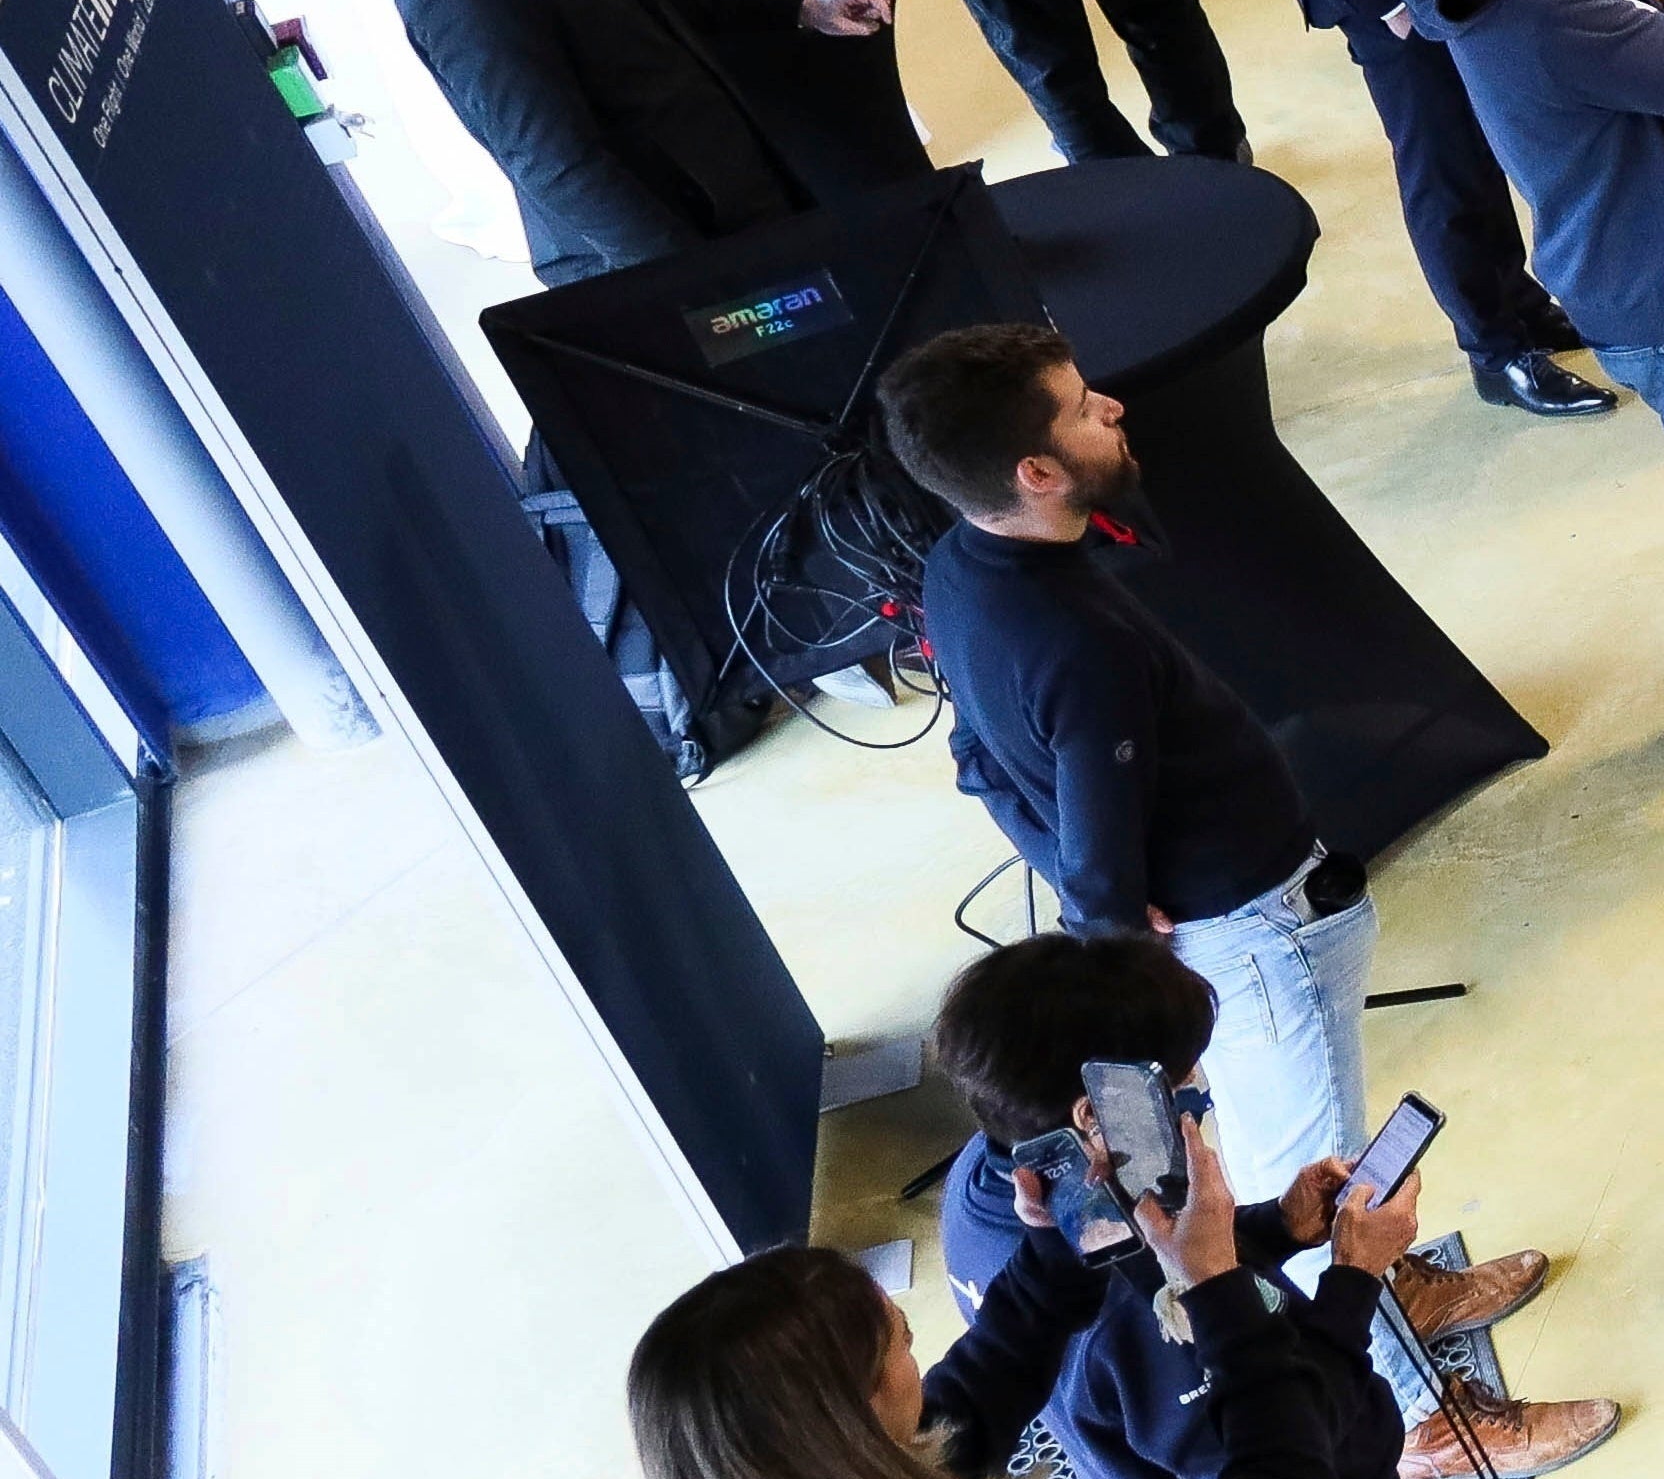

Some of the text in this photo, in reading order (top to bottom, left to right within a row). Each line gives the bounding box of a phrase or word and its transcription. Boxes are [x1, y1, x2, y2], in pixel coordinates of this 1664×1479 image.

[93, 116, 111, 148] One
[117, 47, 134, 78] One
[711, 287, 823, 335] amaran
[755, 319, 795, 337] F22c
